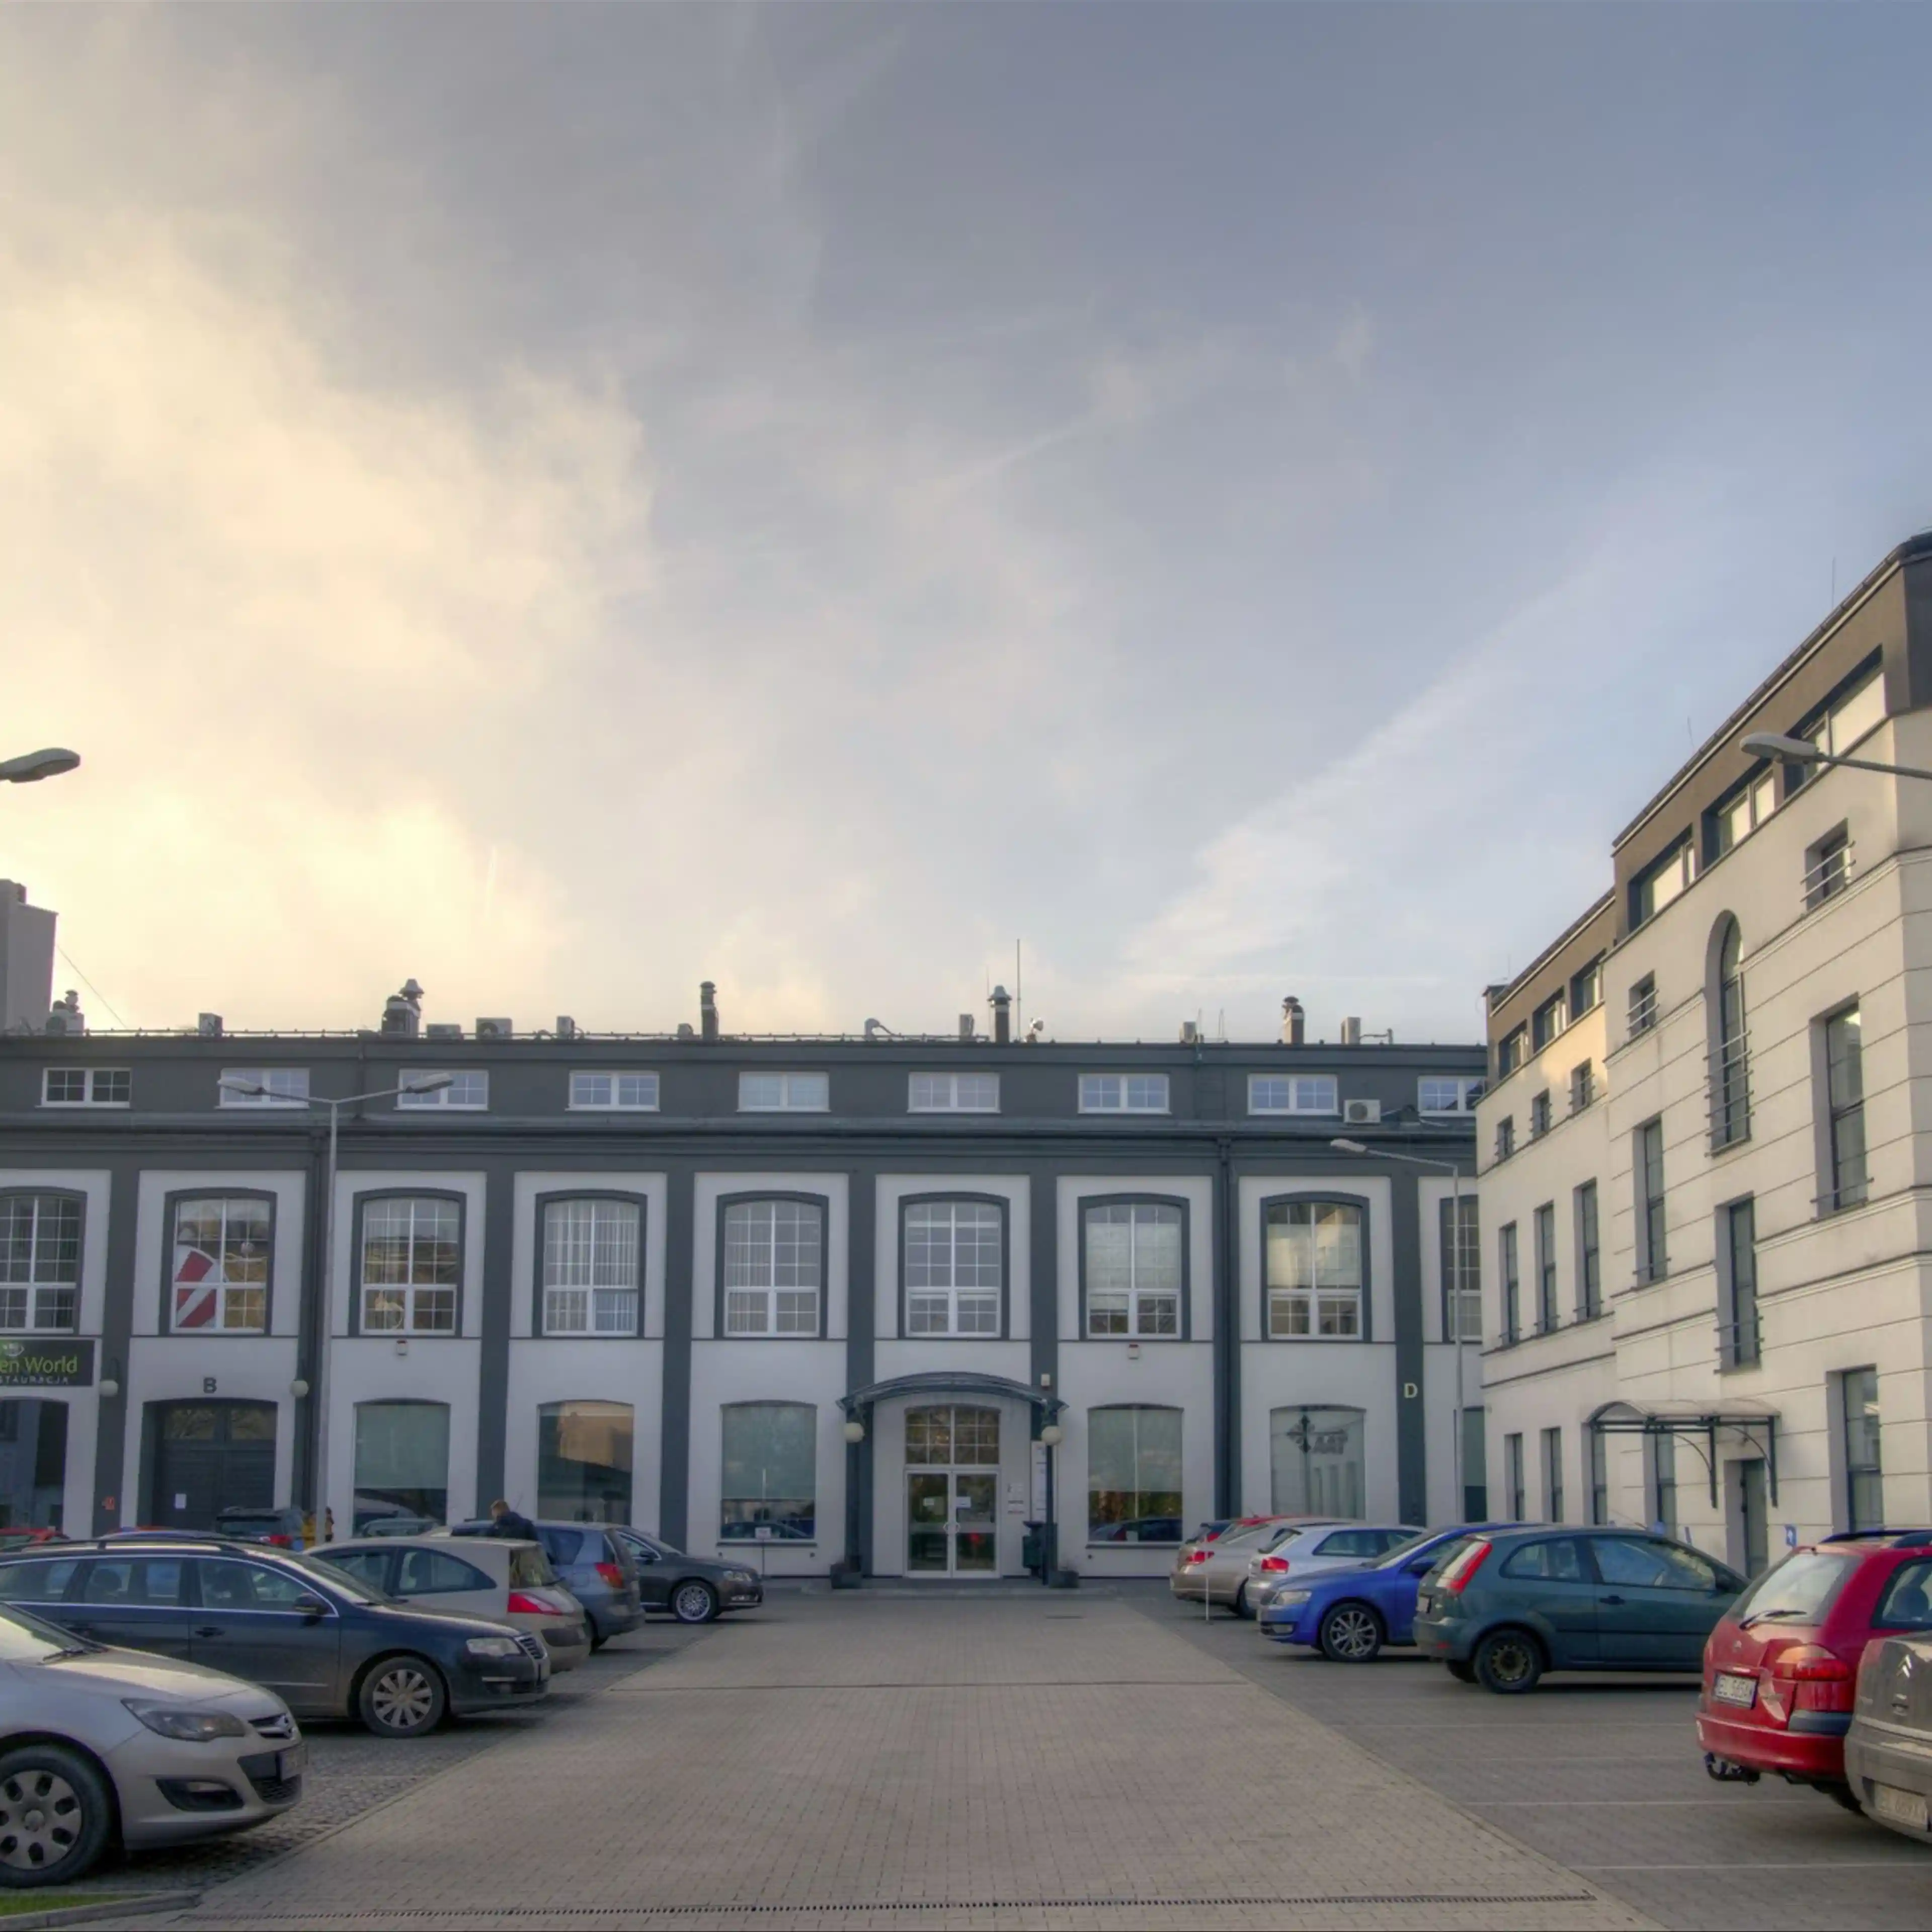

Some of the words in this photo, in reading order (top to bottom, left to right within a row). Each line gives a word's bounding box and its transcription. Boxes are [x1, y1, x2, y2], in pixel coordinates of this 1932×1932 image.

[24, 1354, 77, 1374] World
[203, 1378, 217, 1393] B
[1404, 1383, 1418, 1399] D
